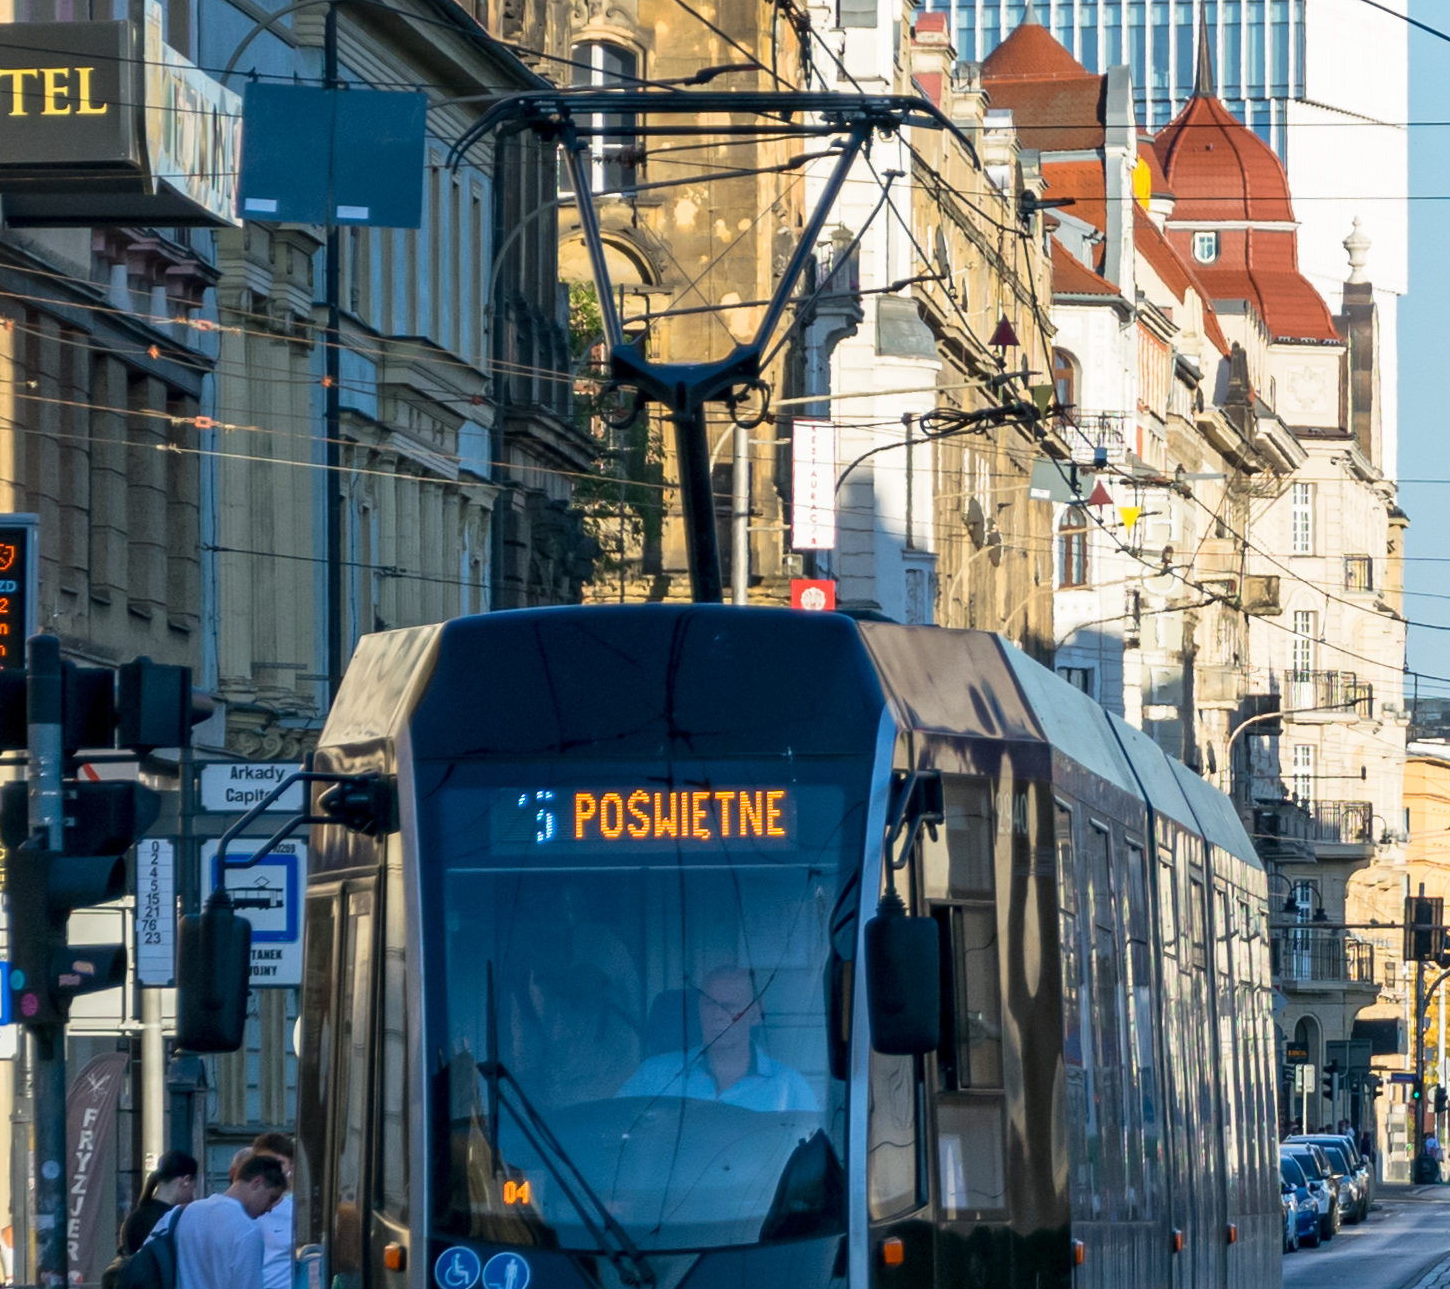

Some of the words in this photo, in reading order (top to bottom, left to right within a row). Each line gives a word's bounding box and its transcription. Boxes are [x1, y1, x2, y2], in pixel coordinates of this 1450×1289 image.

[230, 766, 285, 783] Arkady
[574, 789, 786, 840] POŚWIĘTNE
[152, 842, 160, 852] 0
[150, 854, 159, 865] 2
[149, 867, 158, 878] 4
[150, 880, 159, 892] 5
[147, 893, 160, 904] 15
[145, 906, 160, 918] 21
[142, 919, 157, 931] 76
[145, 932, 161, 944] 23
[67, 1107, 99, 1262] FRYZJER
[502, 1180, 531, 1205] 04
